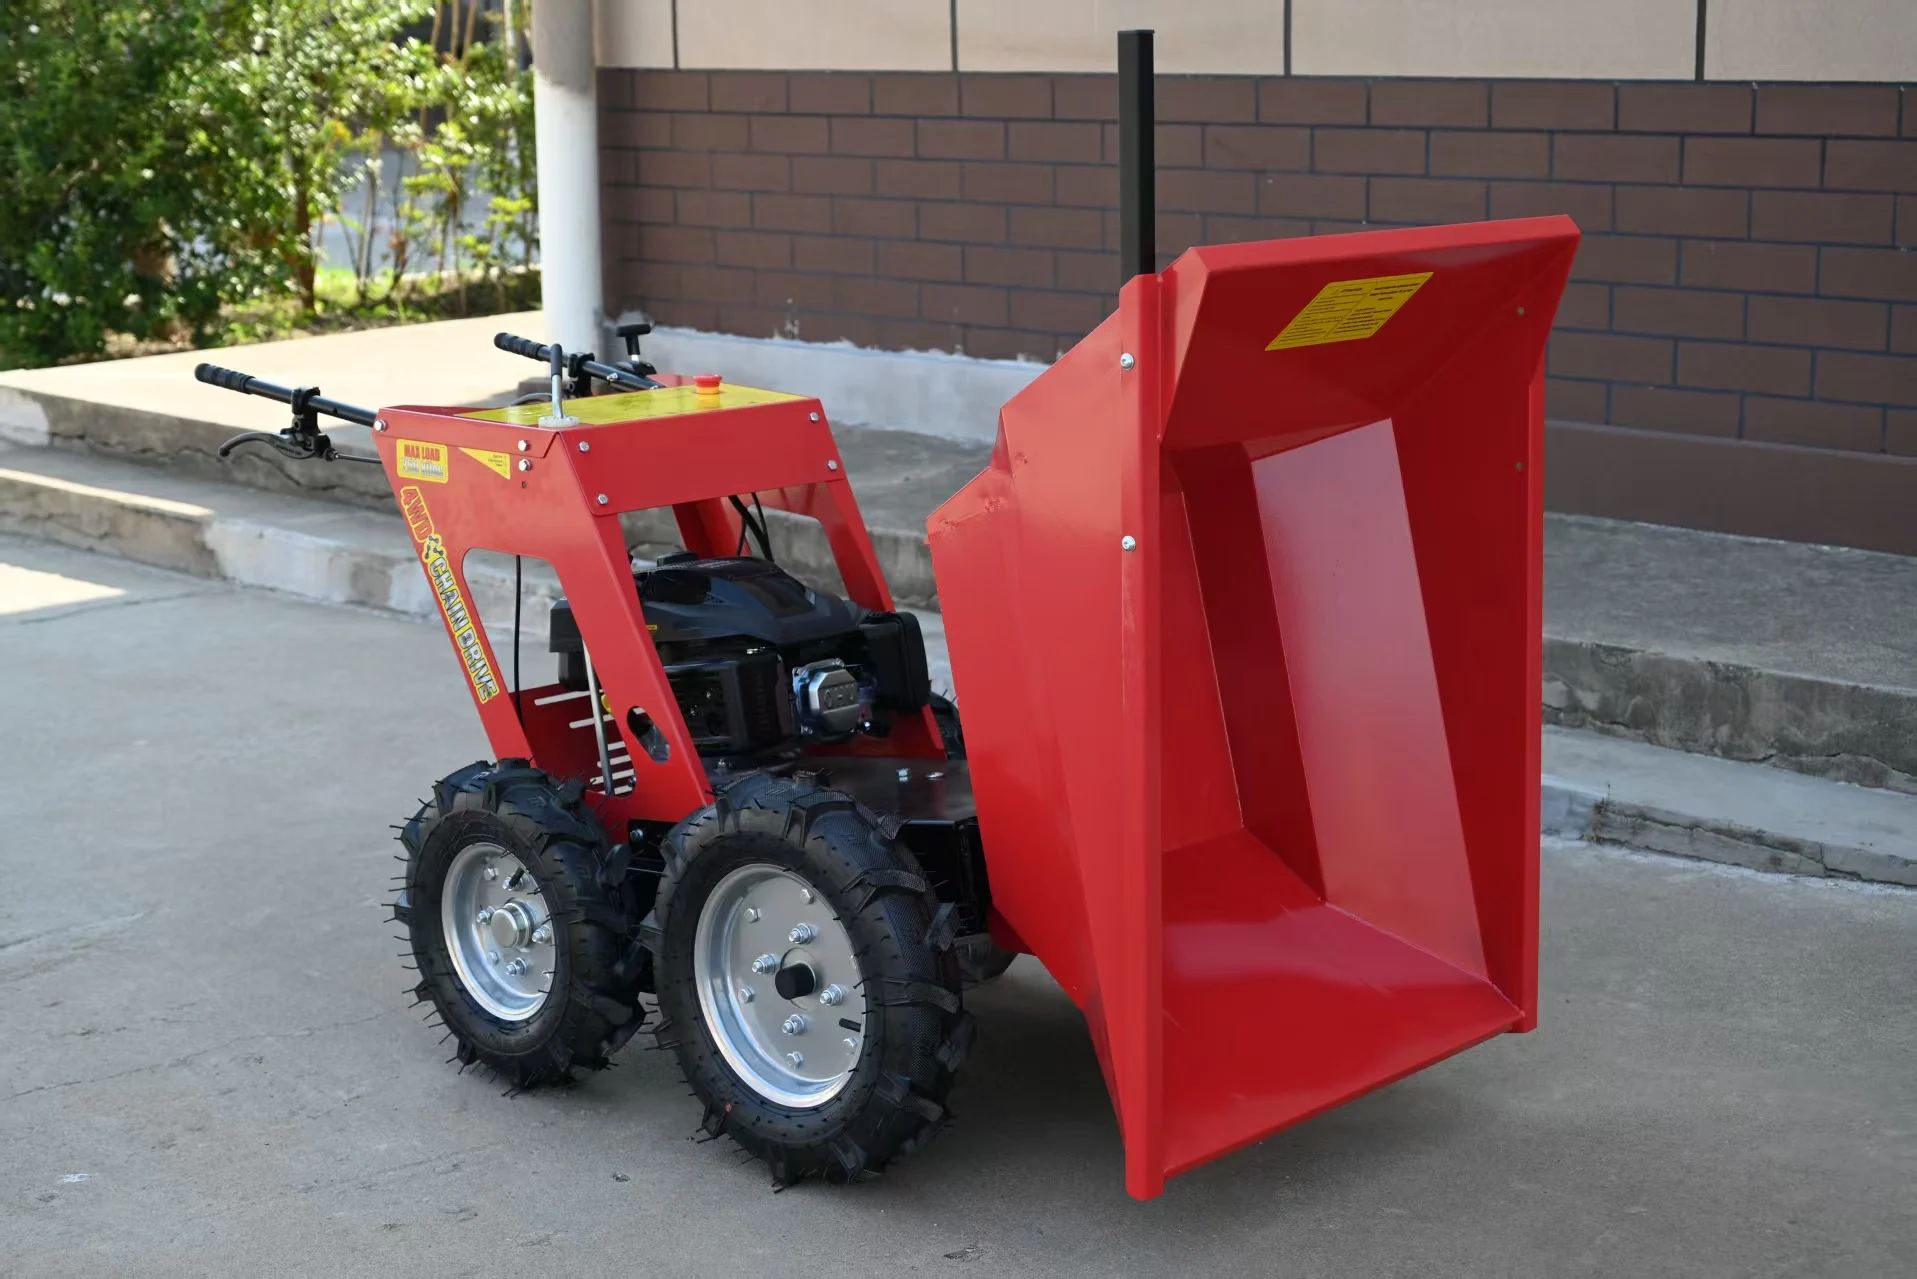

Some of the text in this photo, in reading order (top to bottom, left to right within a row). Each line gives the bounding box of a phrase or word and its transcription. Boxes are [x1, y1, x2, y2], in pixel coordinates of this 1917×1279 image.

[404, 444, 440, 461] MAX LOAD
[402, 488, 498, 701] 4WD CHAIN DRIVE
